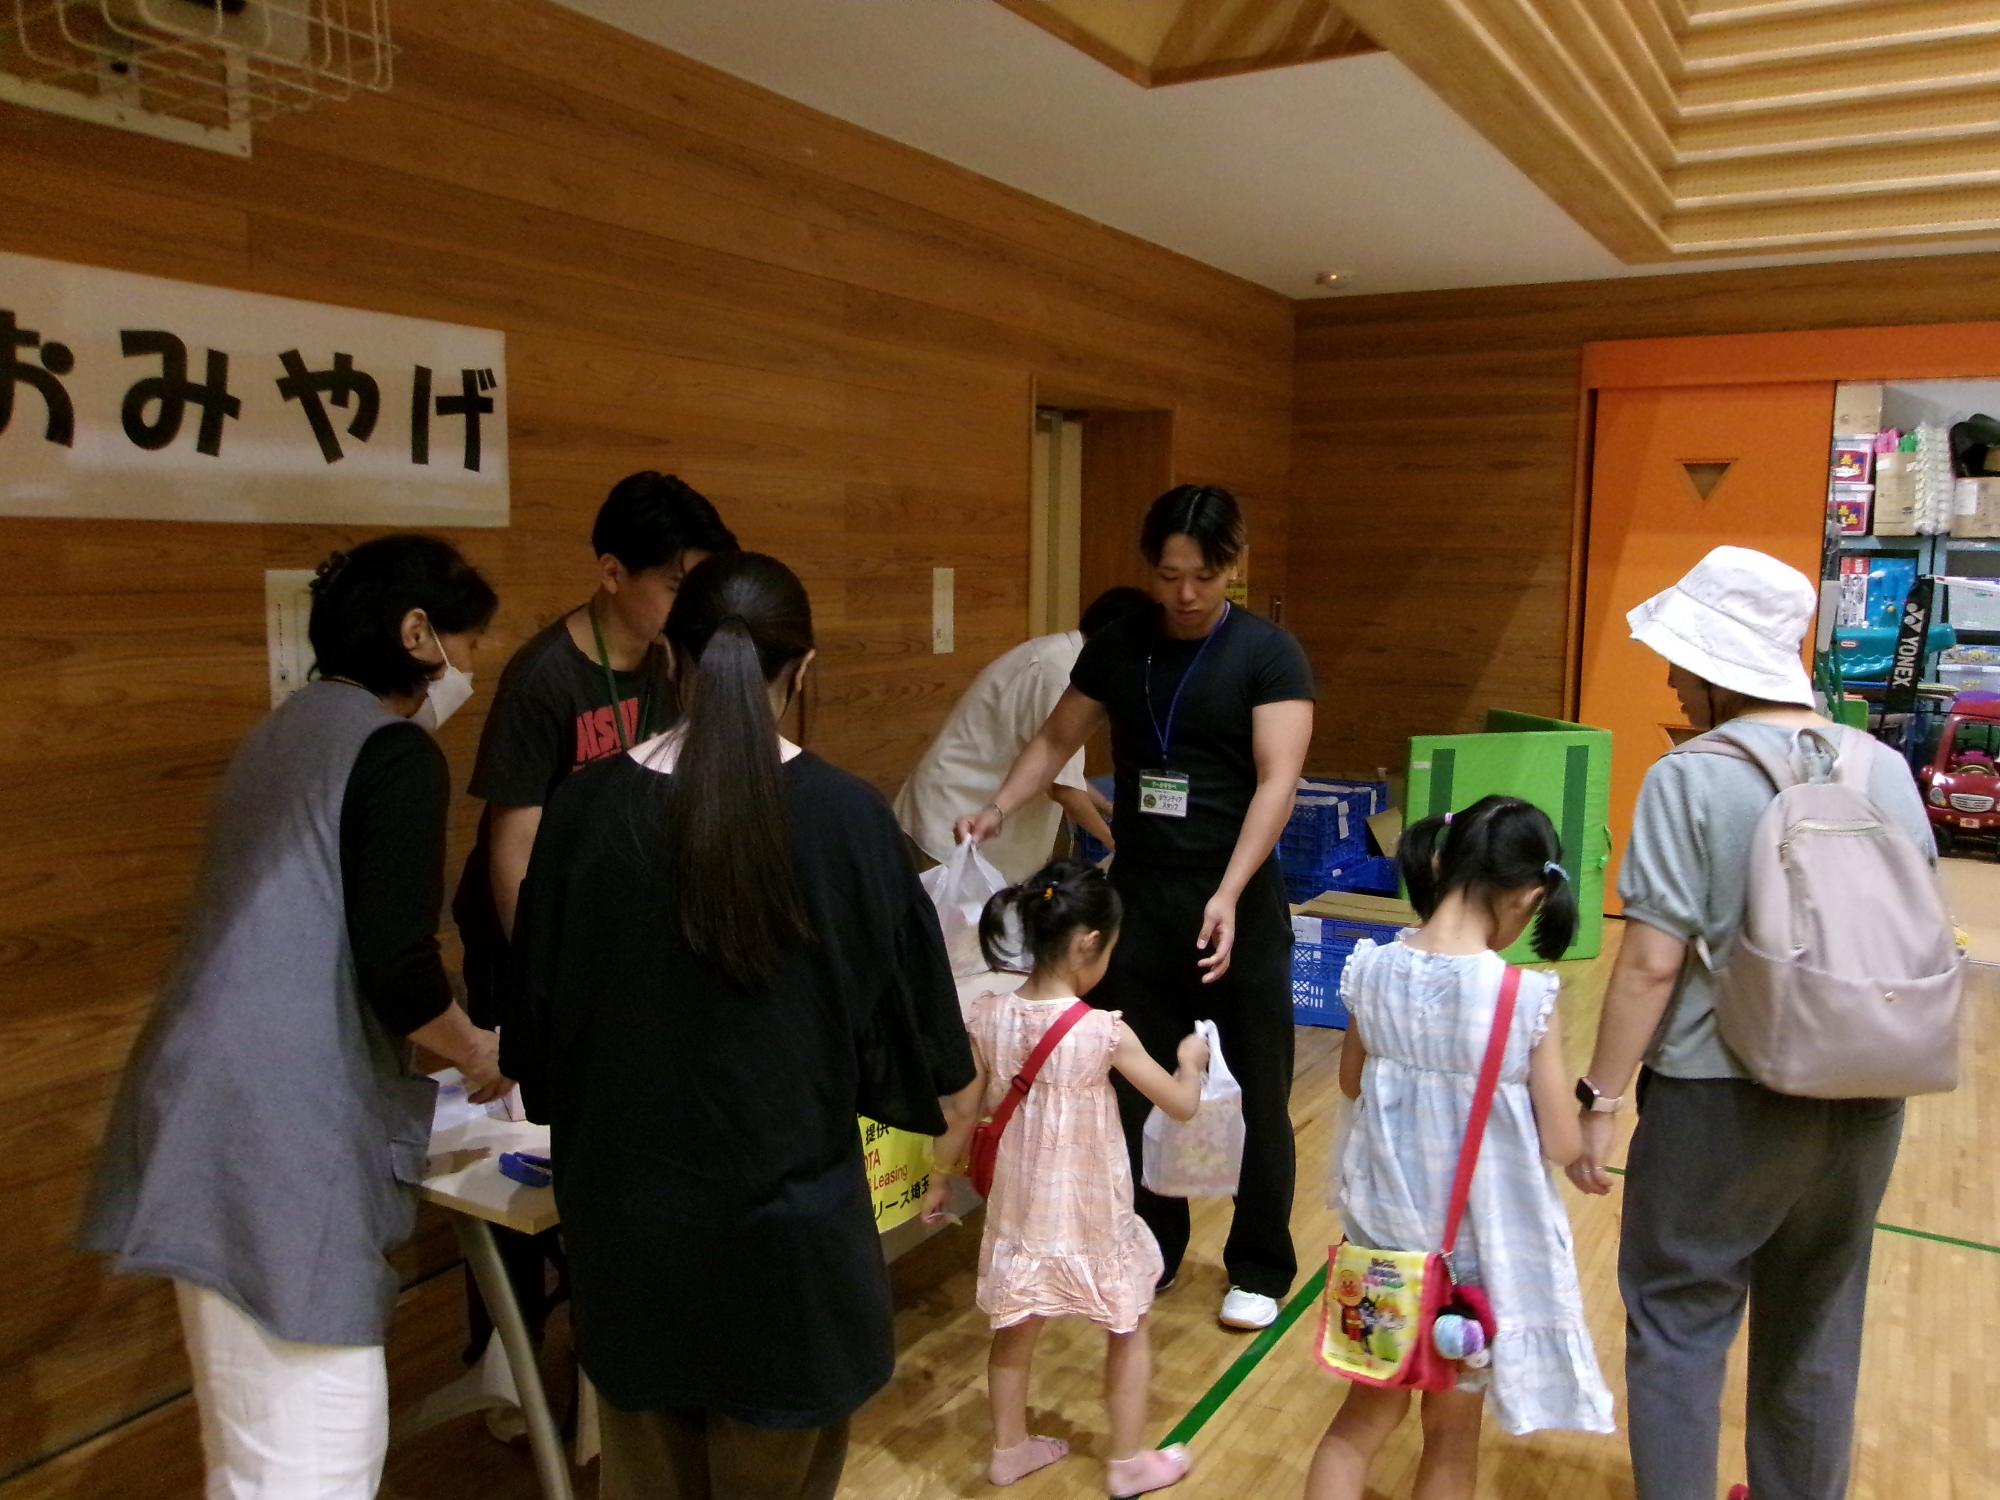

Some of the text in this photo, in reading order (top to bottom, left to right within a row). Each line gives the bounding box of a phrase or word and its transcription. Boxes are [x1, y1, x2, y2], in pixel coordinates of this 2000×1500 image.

[0, 308, 497, 471] おみやげ
[1892, 637, 1919, 686] YONEX
[867, 1123, 889, 1147] 提供
[873, 1164, 908, 1191] Leasing
